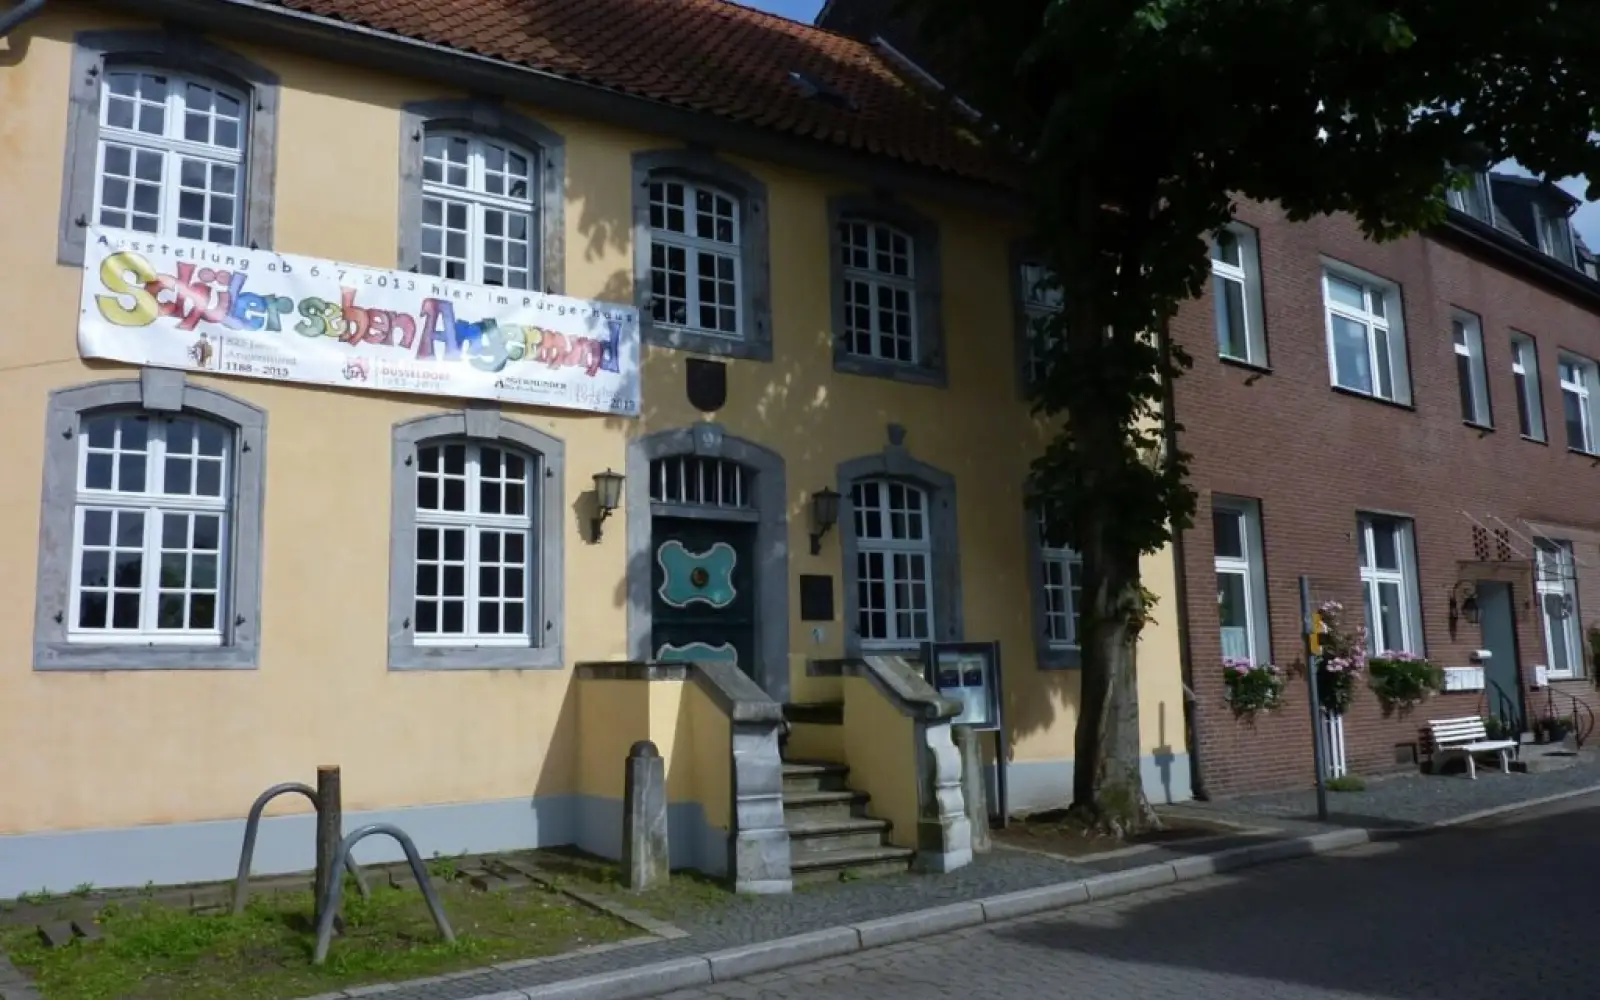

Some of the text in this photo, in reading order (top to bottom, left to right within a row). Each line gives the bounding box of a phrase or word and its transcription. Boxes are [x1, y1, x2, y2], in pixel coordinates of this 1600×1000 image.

[94, 251, 620, 377] Schüler sehen Angermund
[98, 235, 249, 269] Ausstellung
[268, 260, 292, 273] ab
[432, 284, 472, 298] hier
[488, 290, 508, 303] im
